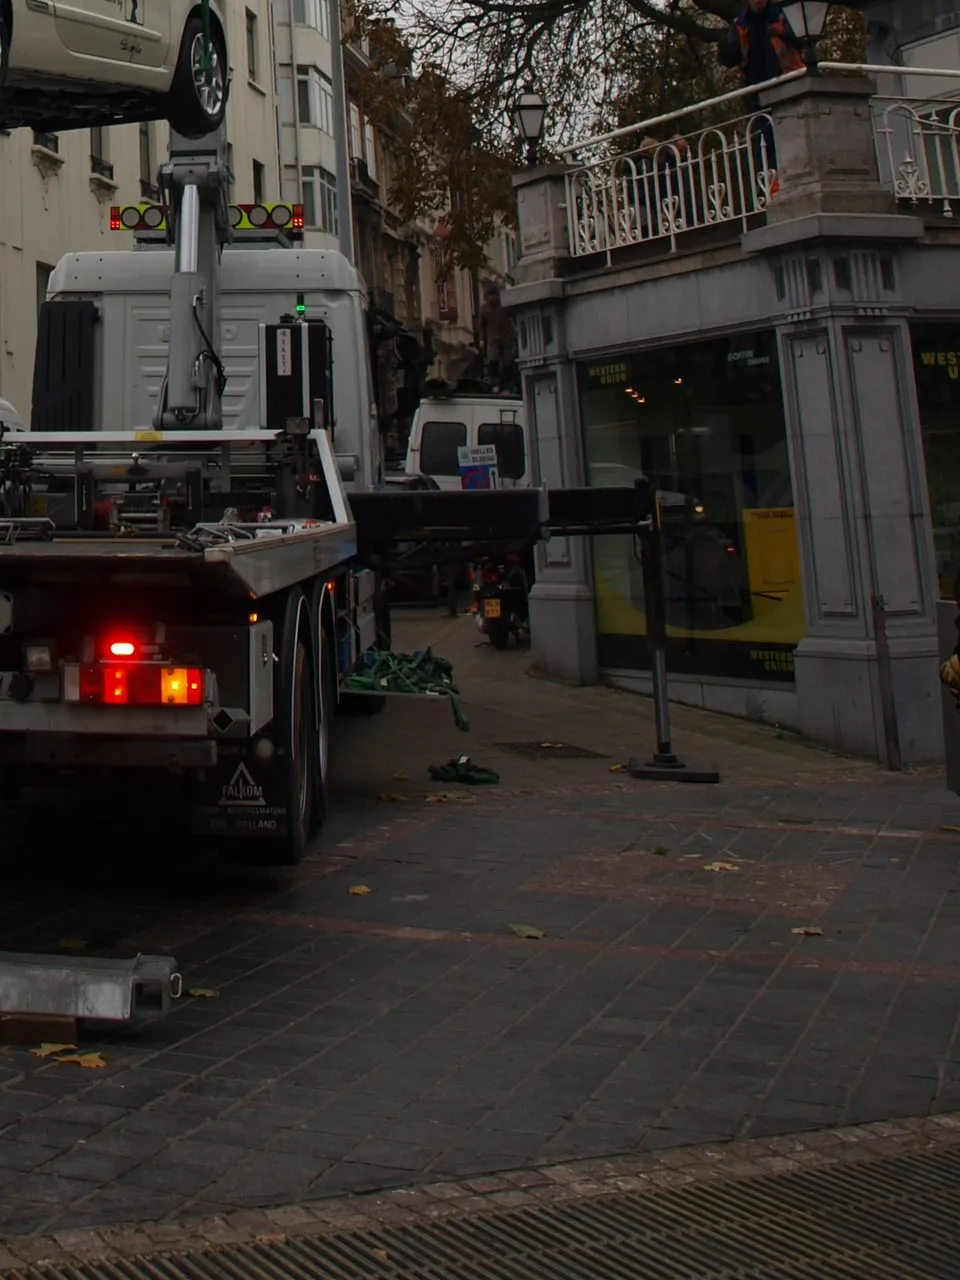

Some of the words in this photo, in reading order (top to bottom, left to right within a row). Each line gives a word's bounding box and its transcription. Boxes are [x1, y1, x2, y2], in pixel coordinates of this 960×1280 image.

[921, 351, 960, 366] WES
[588, 363, 626, 378] WESTERN
[600, 372, 627, 386] UNION
[222, 783, 263, 798] FALKOM
